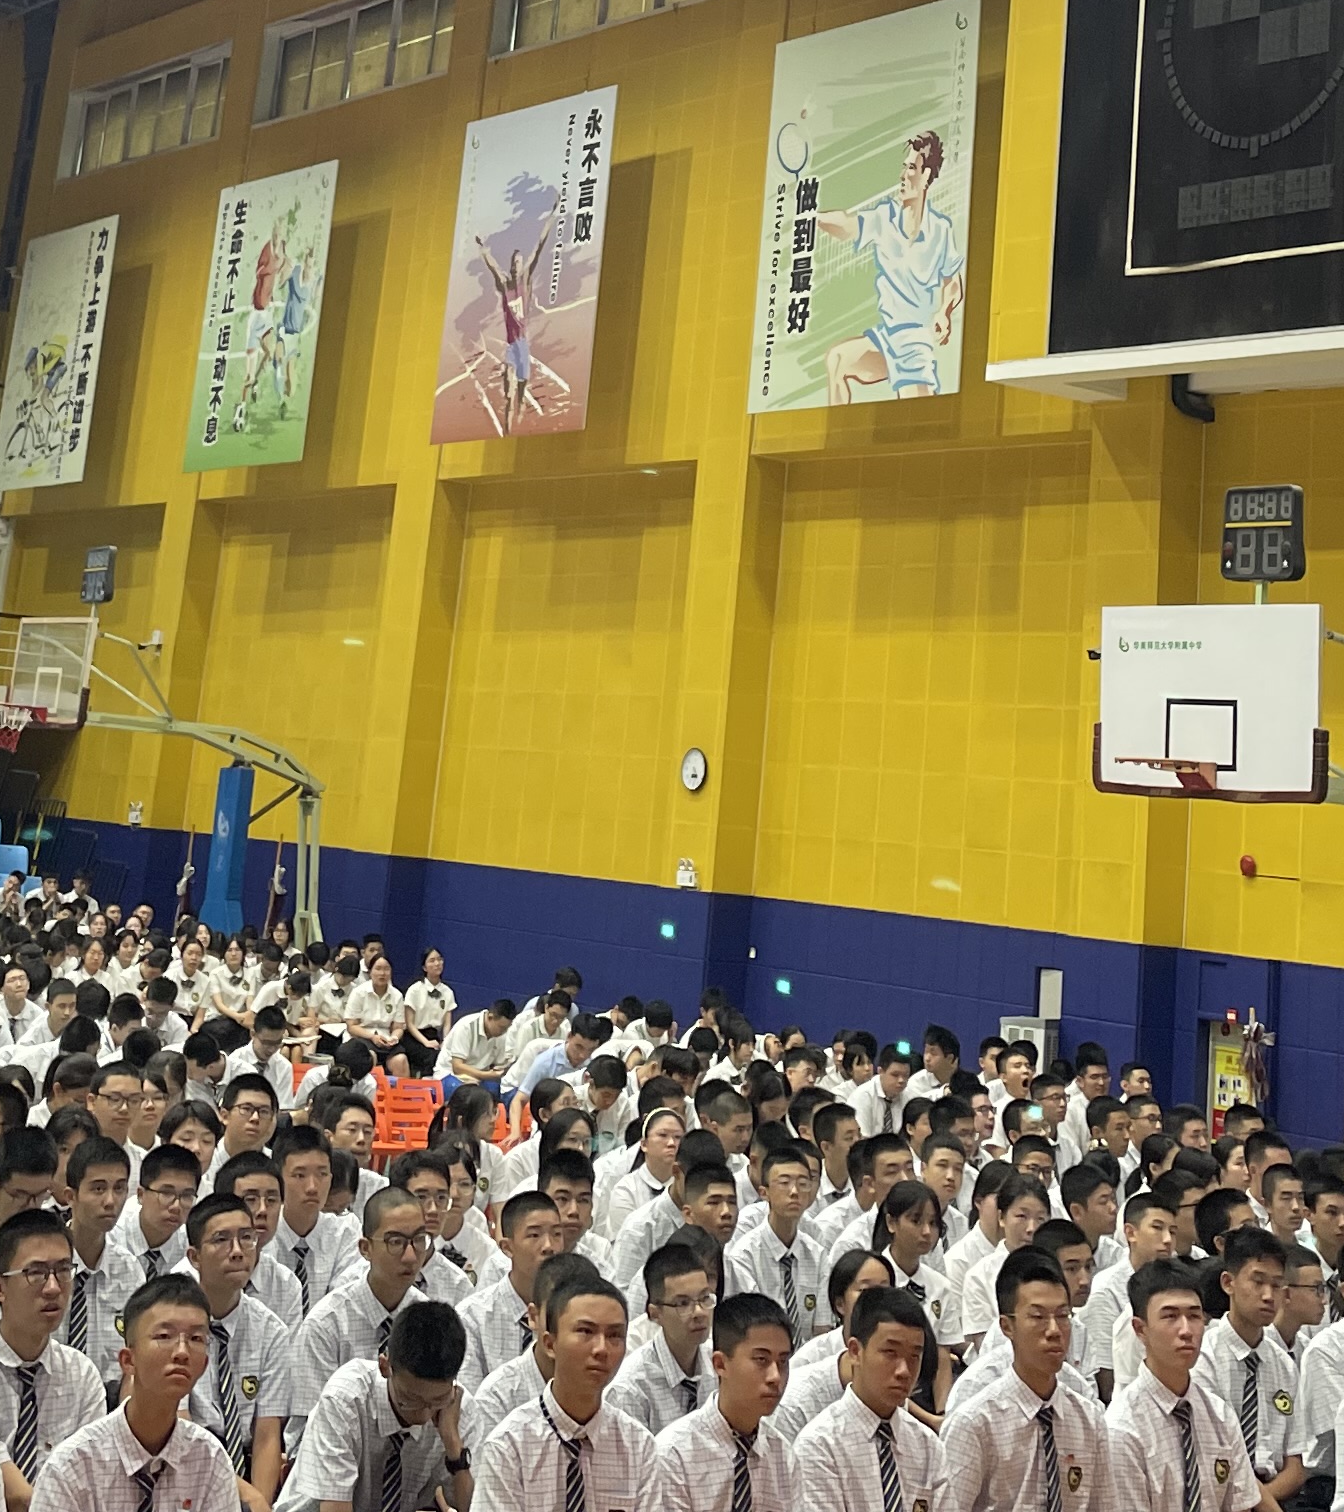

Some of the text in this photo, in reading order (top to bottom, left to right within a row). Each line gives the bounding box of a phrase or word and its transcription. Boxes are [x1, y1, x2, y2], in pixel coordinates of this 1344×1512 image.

[559, 171, 570, 214] yield
[565, 113, 577, 166] Never
[573, 108, 603, 244] 永不言败
[84, 227, 109, 334] 力争上游
[557, 219, 565, 237] to
[787, 177, 819, 334] 做到最好
[204, 198, 248, 444] 生命不止 运动不息
[762, 183, 786, 397] Strive for excellence
[68, 343, 94, 454] 不断进步
